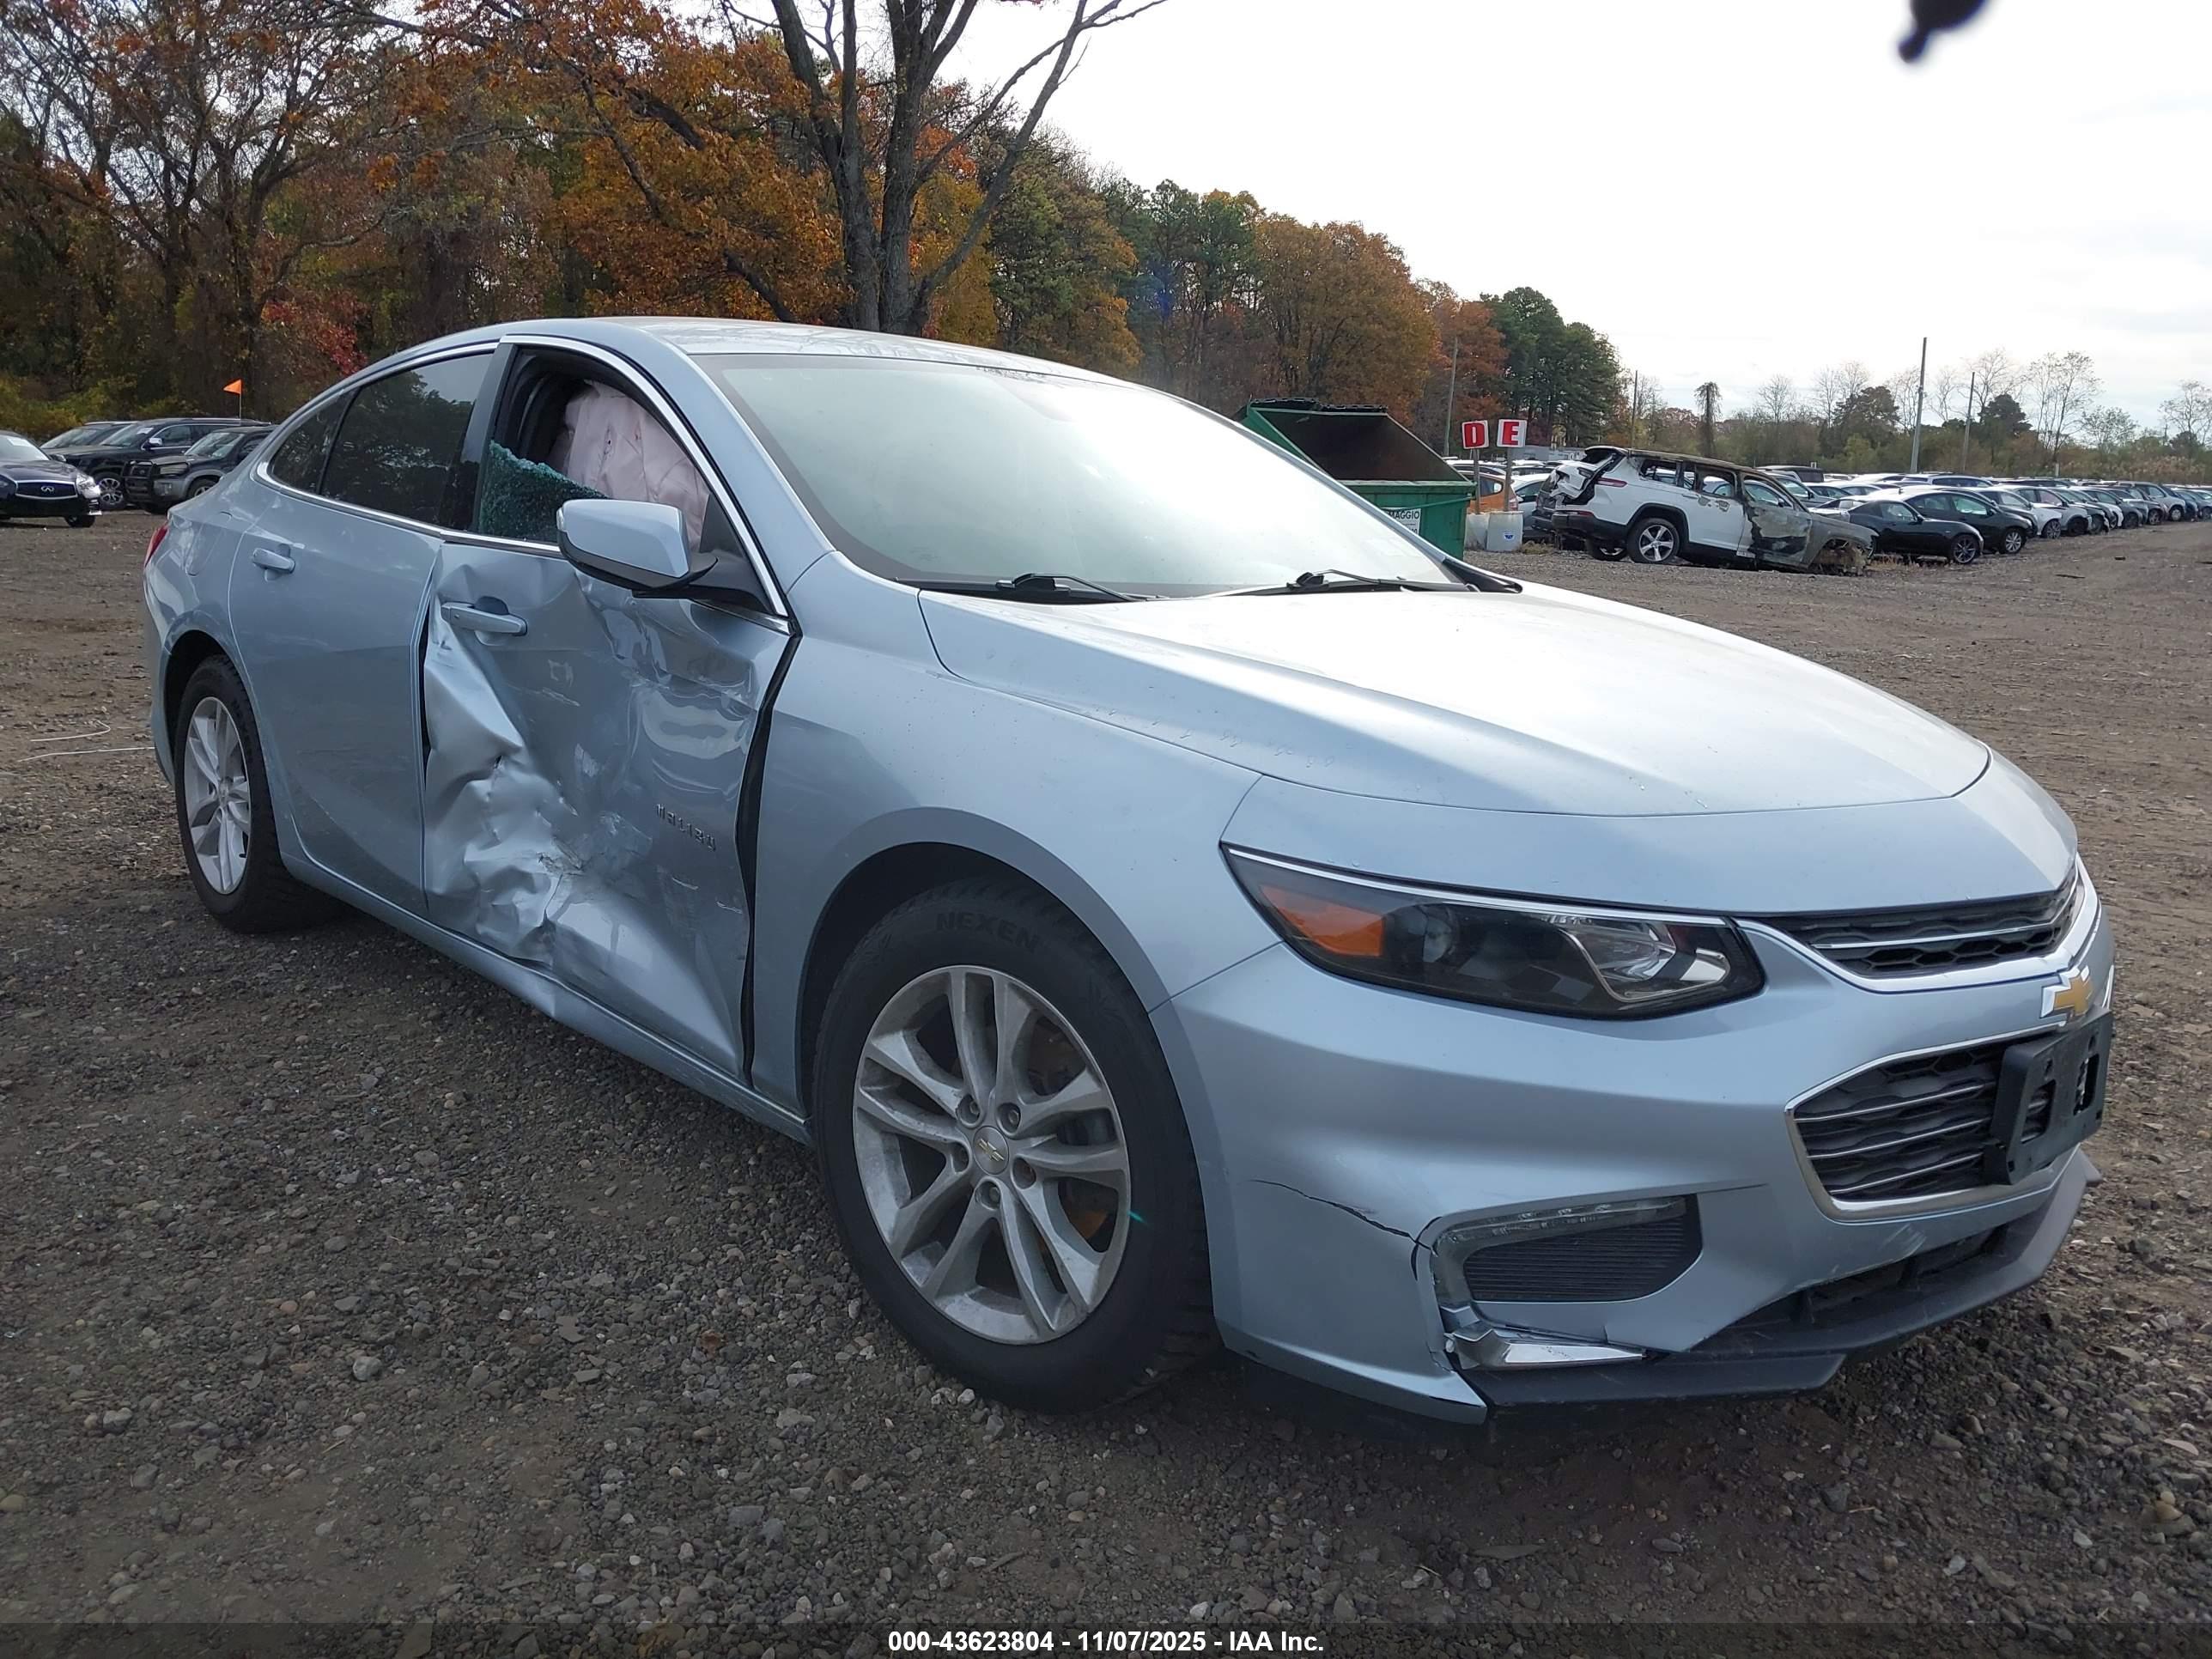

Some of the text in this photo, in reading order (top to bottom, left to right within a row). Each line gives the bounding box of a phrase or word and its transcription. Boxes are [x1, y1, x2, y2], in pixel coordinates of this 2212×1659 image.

[1464, 422, 1485, 447] D
[1501, 421, 1519, 446] E
[935, 911, 1041, 954] NEXEN
